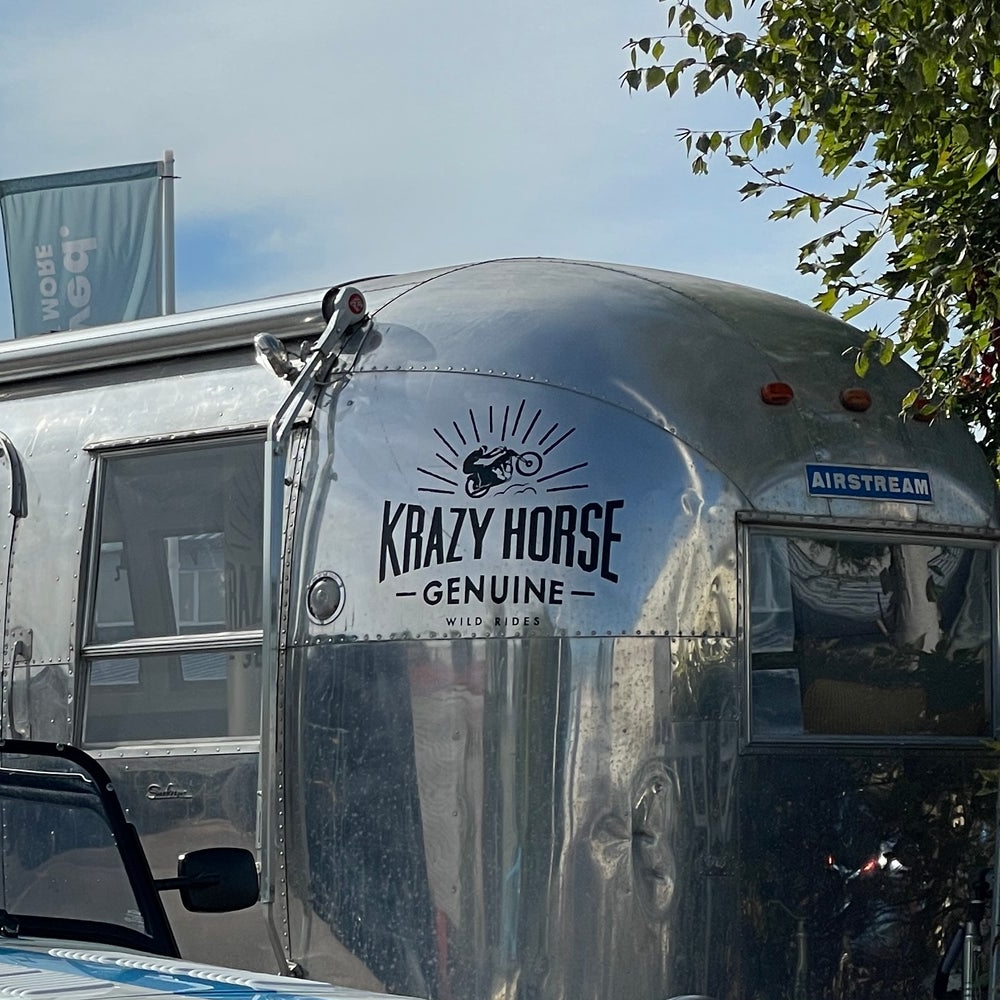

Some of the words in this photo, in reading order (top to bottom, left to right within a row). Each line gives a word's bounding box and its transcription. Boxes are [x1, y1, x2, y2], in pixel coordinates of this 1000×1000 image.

[811, 471, 930, 496] AIRSTREAM
[379, 500, 495, 584] KRAZY
[502, 499, 625, 584] HORSE
[422, 575, 565, 606] GENUINE
[446, 616, 482, 626] WILD
[494, 616, 541, 626] RIDES
